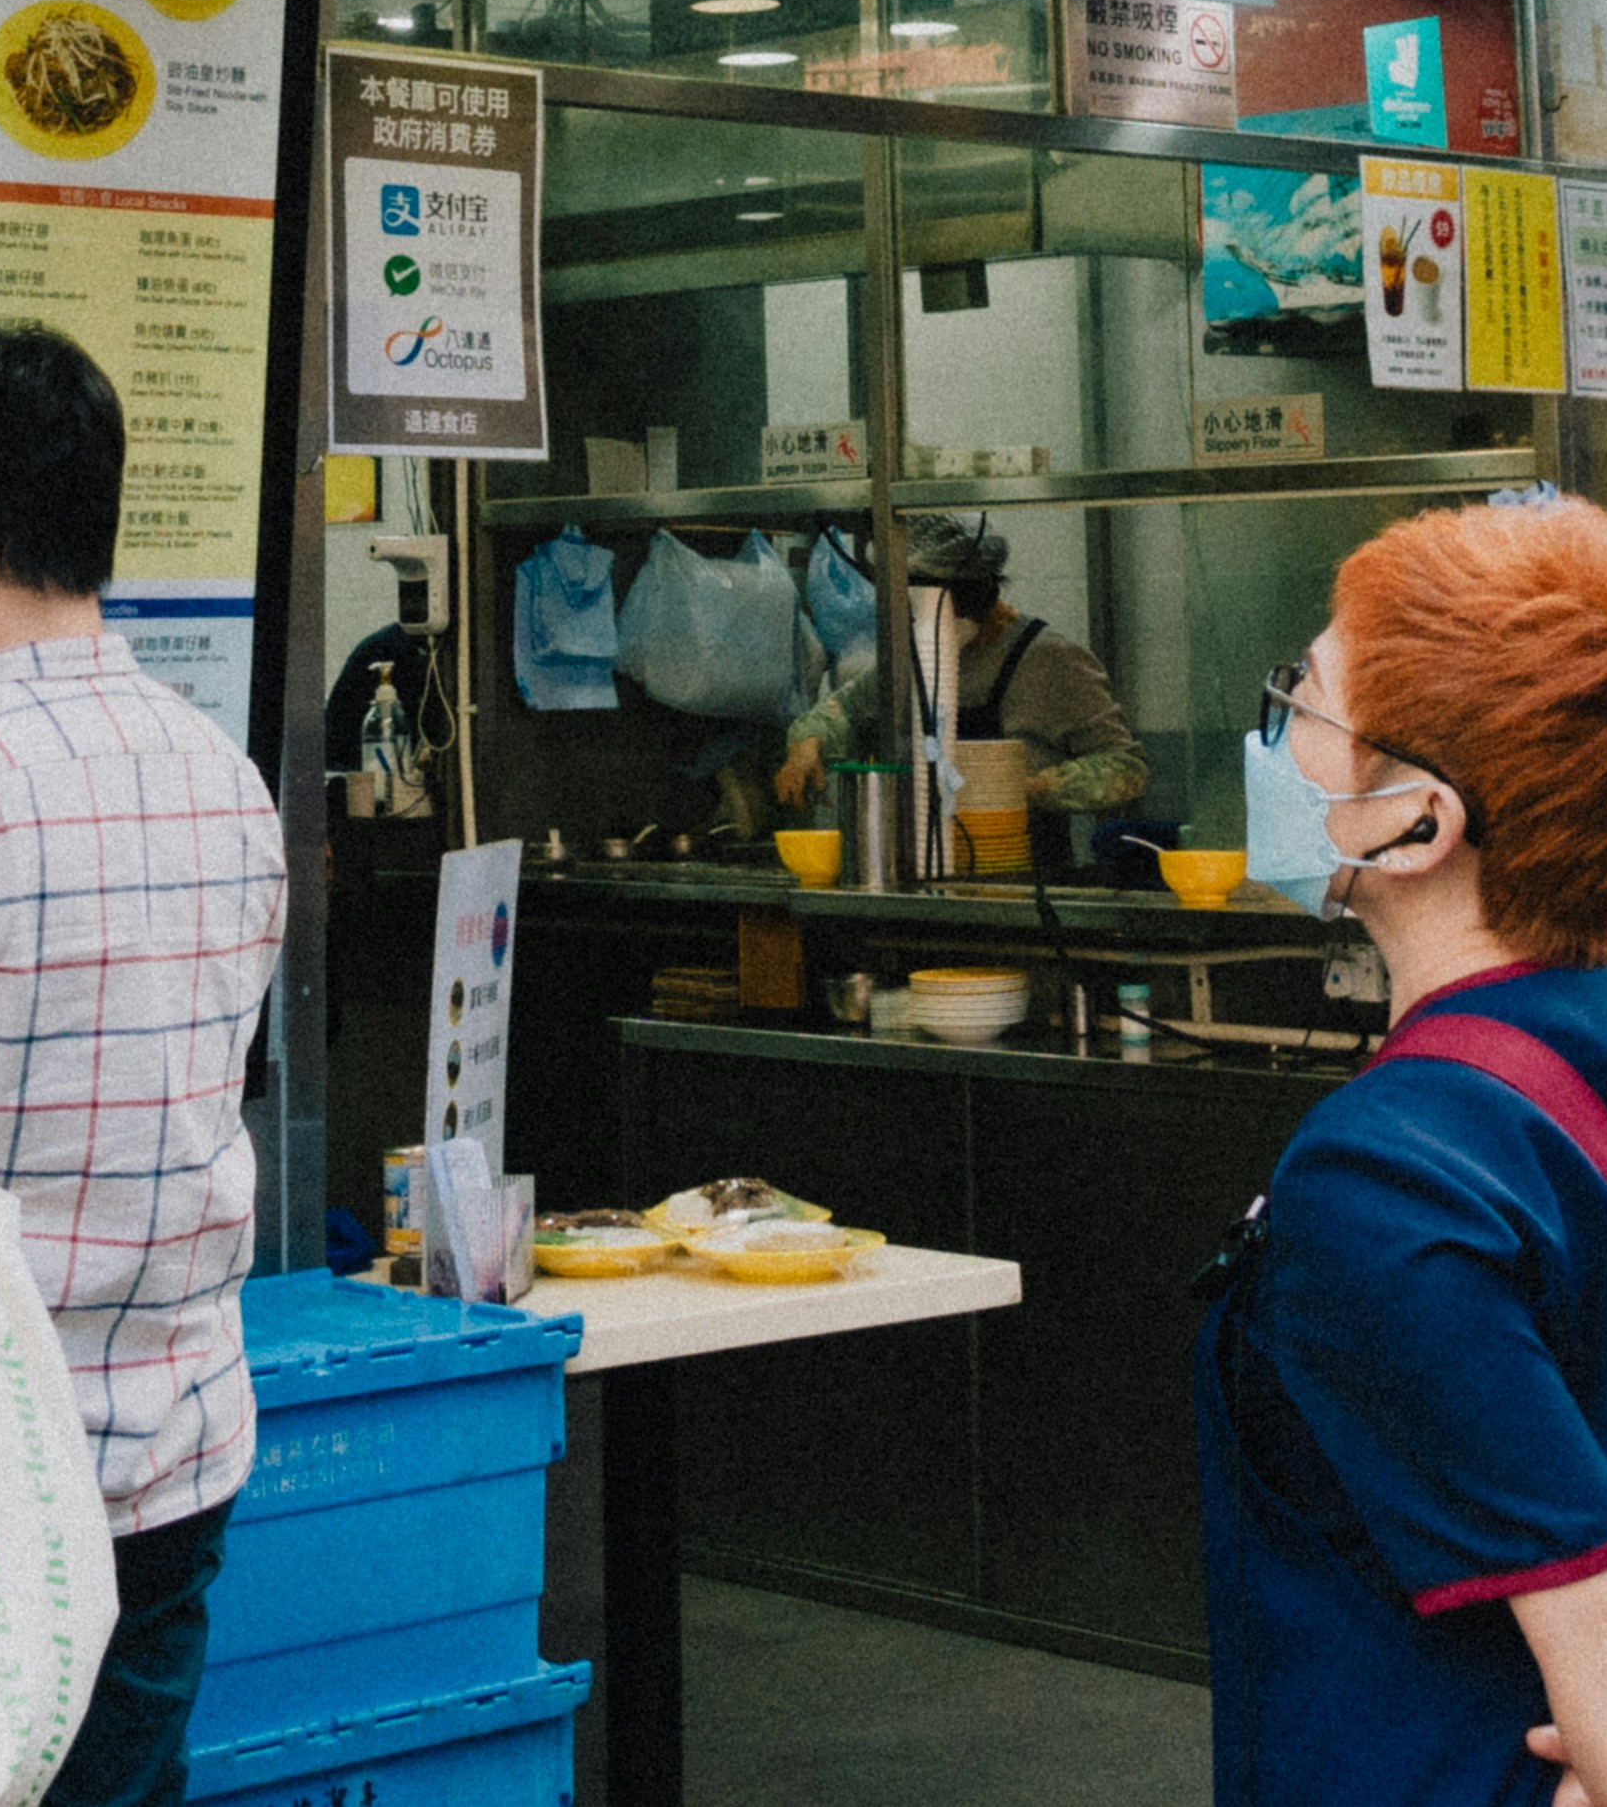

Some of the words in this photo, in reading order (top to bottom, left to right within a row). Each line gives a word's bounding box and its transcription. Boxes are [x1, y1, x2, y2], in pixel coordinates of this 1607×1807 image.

[1087, 39, 1109, 57] NO
[1113, 42, 1183, 66] SMOKING
[359, 75, 510, 119] 本餐廳可使用
[372, 116, 498, 157] 政府消費券
[427, 222, 488, 240] ALIPAY
[444, 327, 492, 351] 八達通
[424, 347, 493, 373] Octopus
[404, 409, 478, 436] 通達食店
[1203, 406, 1283, 435] 小心地滑
[765, 429, 828, 457] 小心地滑
[1204, 438, 1250, 453] Slippery
[1252, 435, 1281, 449] Floor
[103, 603, 140, 617] oodles
[44, 1526, 70, 1611] the
